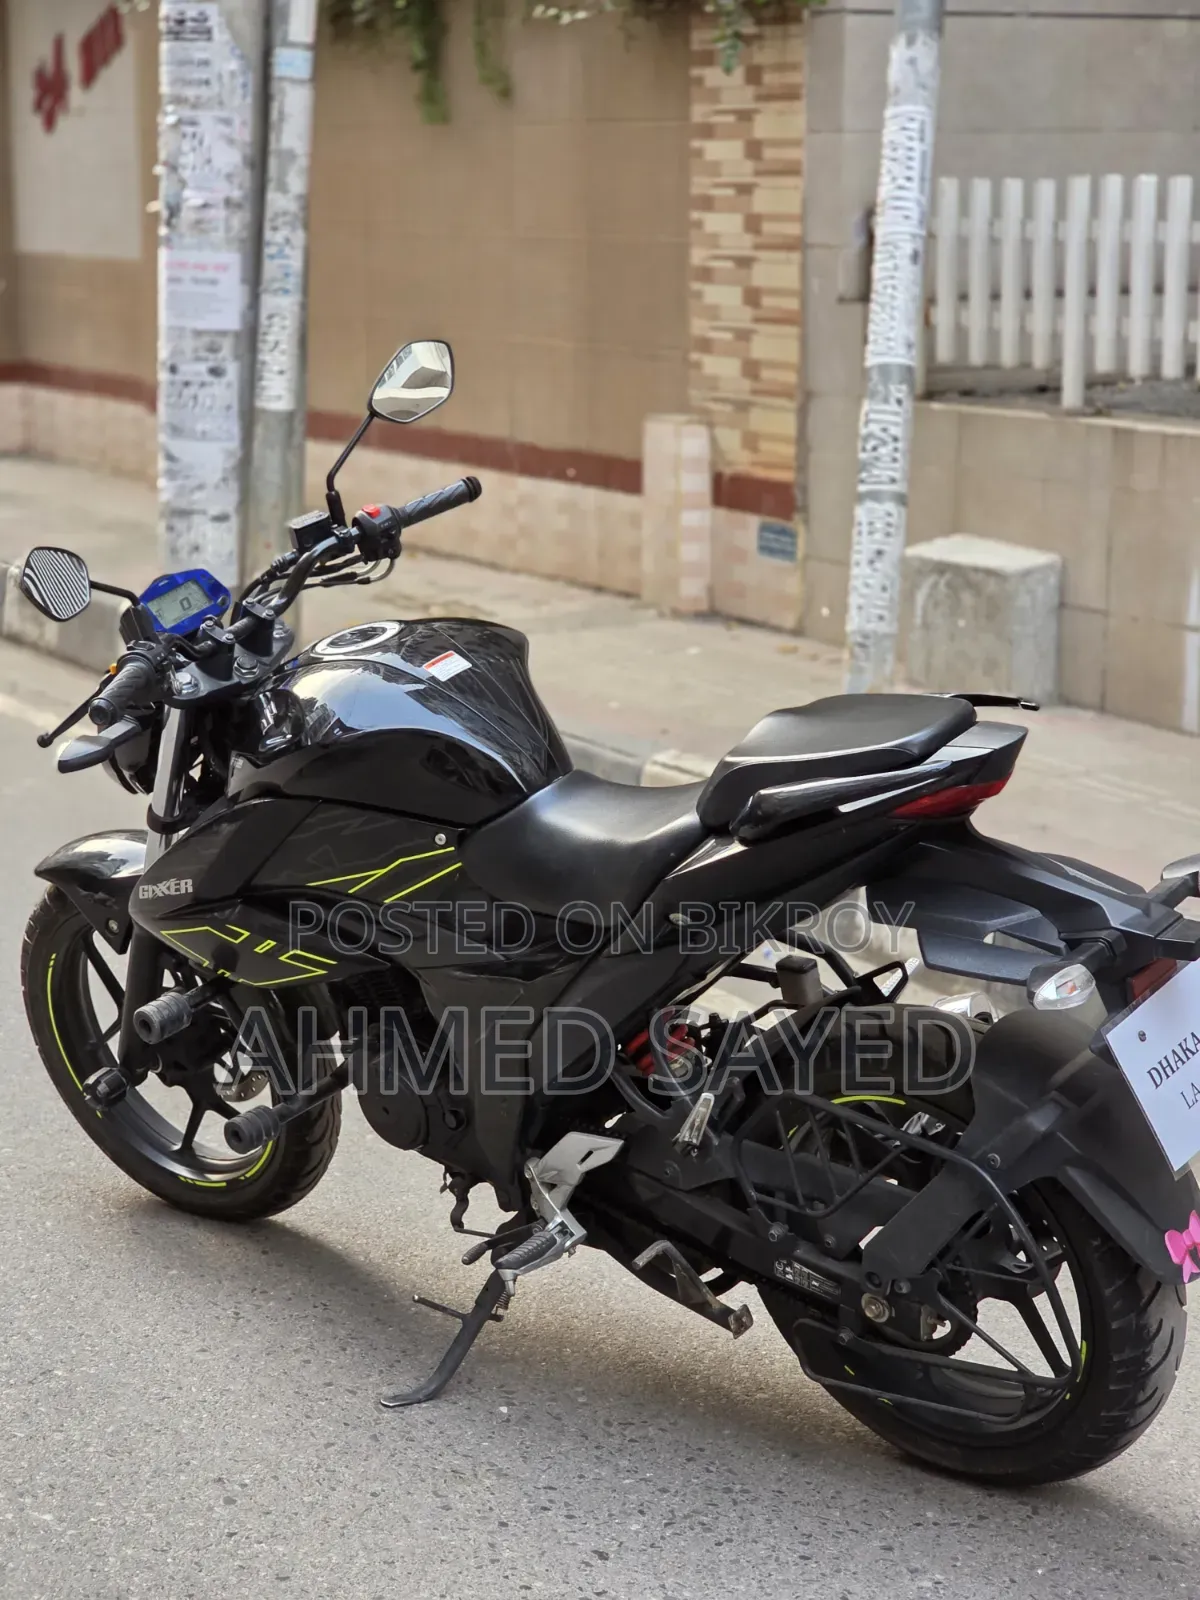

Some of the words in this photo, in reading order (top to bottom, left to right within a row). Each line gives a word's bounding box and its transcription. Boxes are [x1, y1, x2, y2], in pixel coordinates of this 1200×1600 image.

[179, 597, 192, 611] 0
[139, 878, 193, 899] GIXXER
[1146, 1031, 1200, 1090] DHAKA
[1180, 1082, 1200, 1110] LA
